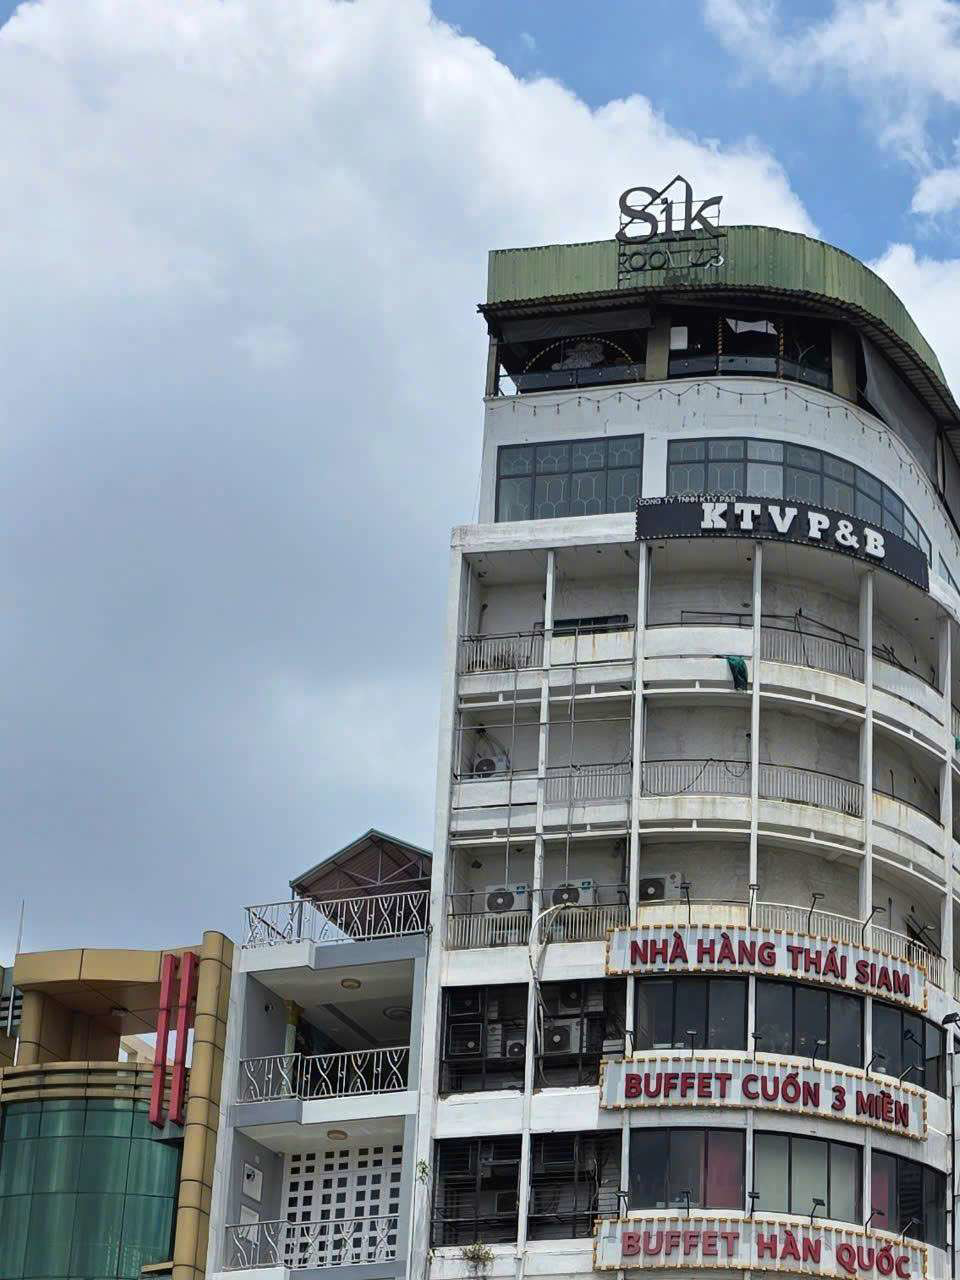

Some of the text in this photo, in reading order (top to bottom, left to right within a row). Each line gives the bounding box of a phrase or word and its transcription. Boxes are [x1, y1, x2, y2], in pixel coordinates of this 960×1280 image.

[615, 174, 723, 243] Sik
[700, 502, 886, 559] KTV P&B
[630, 930, 911, 997] NHÀ HÀNG THÁI SIAM
[624, 1066, 910, 1128] BUFFET CUỐN 3 MIỀN
[621, 1227, 911, 1279] BUFFET HÀN QUỐC
